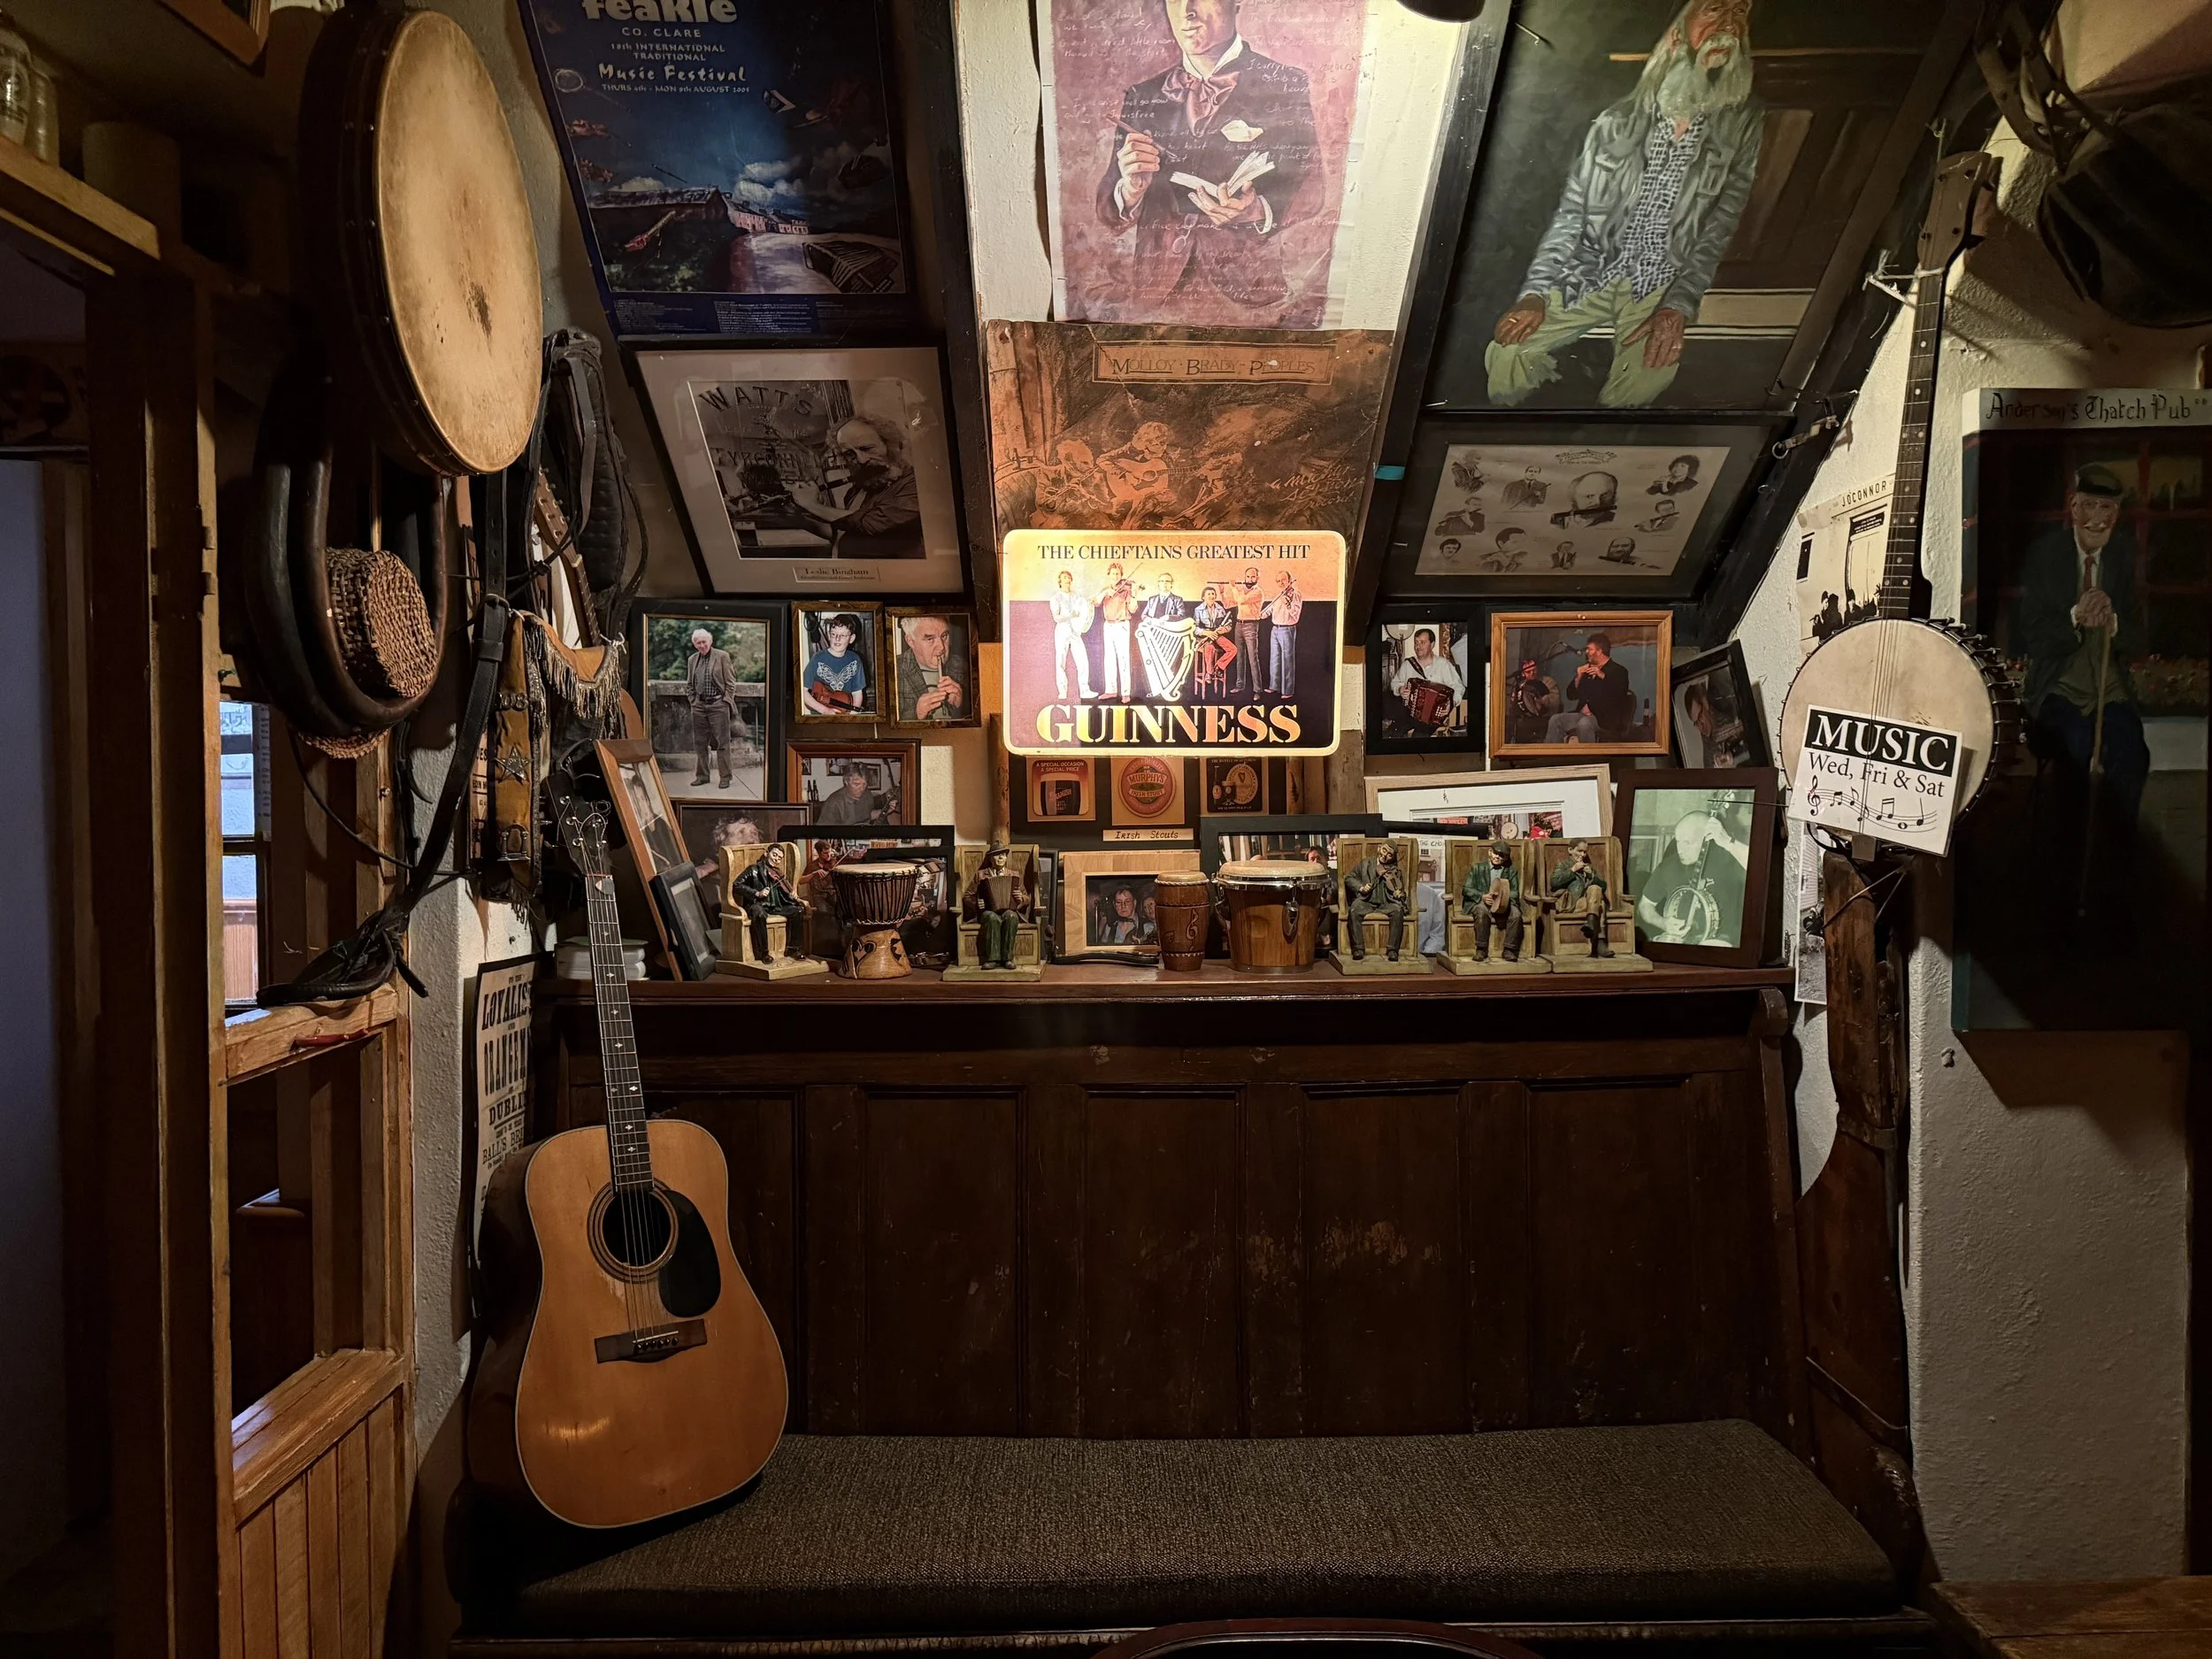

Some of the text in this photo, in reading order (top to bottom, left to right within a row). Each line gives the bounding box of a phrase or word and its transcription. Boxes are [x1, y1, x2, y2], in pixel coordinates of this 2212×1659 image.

[621, 27, 702, 38] CO. CLARE
[634, 52, 707, 61] TRADITIONAL
[635, 43, 726, 53] INTERNATIONAL
[598, 63, 746, 81] Music Festival
[1112, 358, 1316, 376] MOLLOY BRADY PEOPLES
[698, 386, 813, 416] WATT'S
[2085, 396, 2146, 423] Thatch
[2150, 394, 2192, 421] Pub
[1038, 544, 1310, 559] THE CHIEFTAINS GREATEST HIT
[1036, 704, 1301, 743] GUINNESS
[1811, 715, 1949, 772] MUSIC
[1809, 752, 1945, 798] Wed, Fri & Sat
[1149, 830, 1179, 840] Stouts
